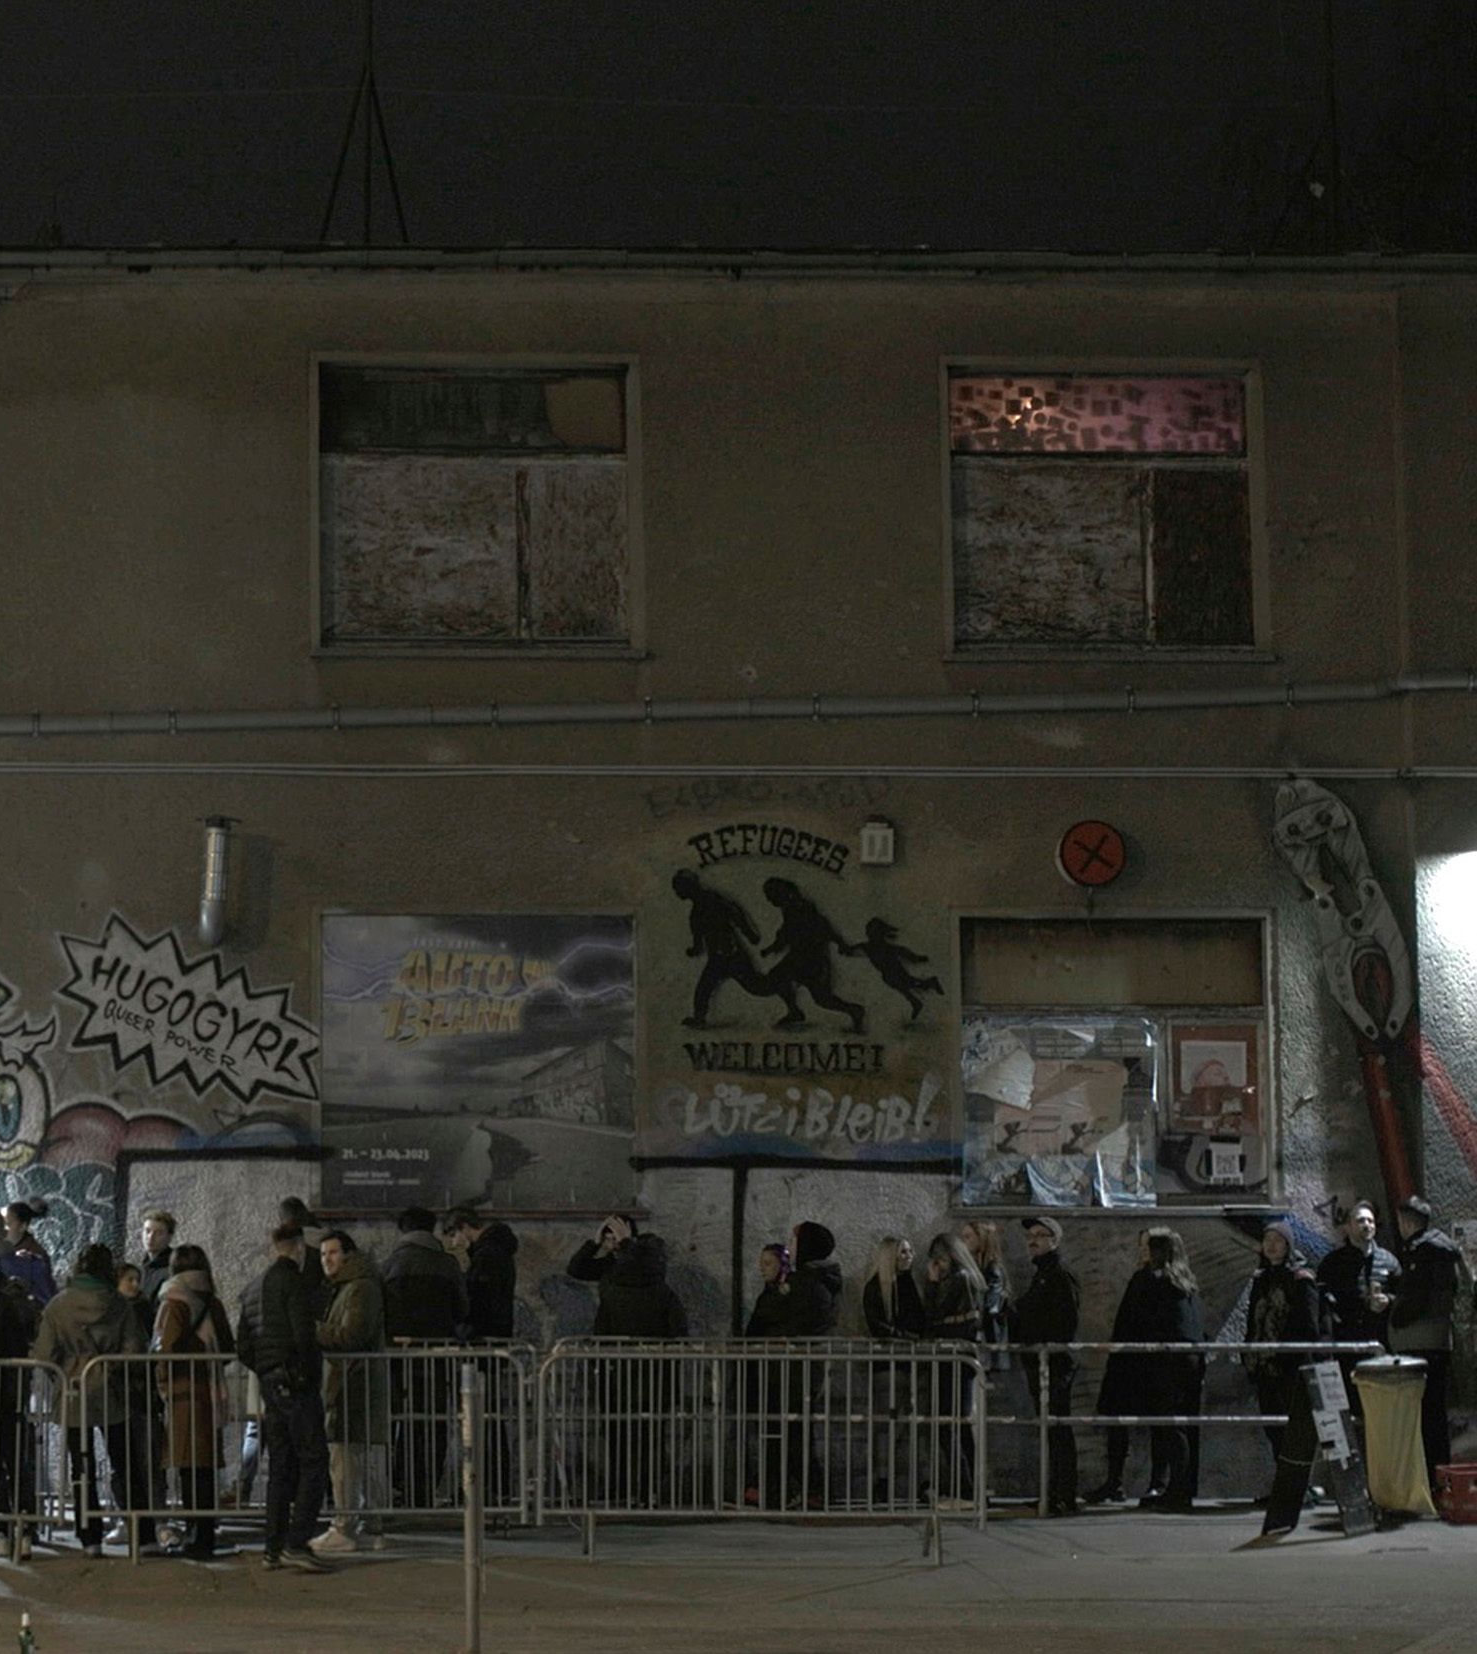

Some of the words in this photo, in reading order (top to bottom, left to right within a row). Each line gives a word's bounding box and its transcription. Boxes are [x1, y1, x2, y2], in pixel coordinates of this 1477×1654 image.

[687, 823, 850, 875] REFUGEES
[91, 955, 301, 1082] HUGOGYRL
[103, 998, 156, 1038] QUEER
[164, 1029, 241, 1077] POWER
[682, 1041, 885, 1072] WELCOME!
